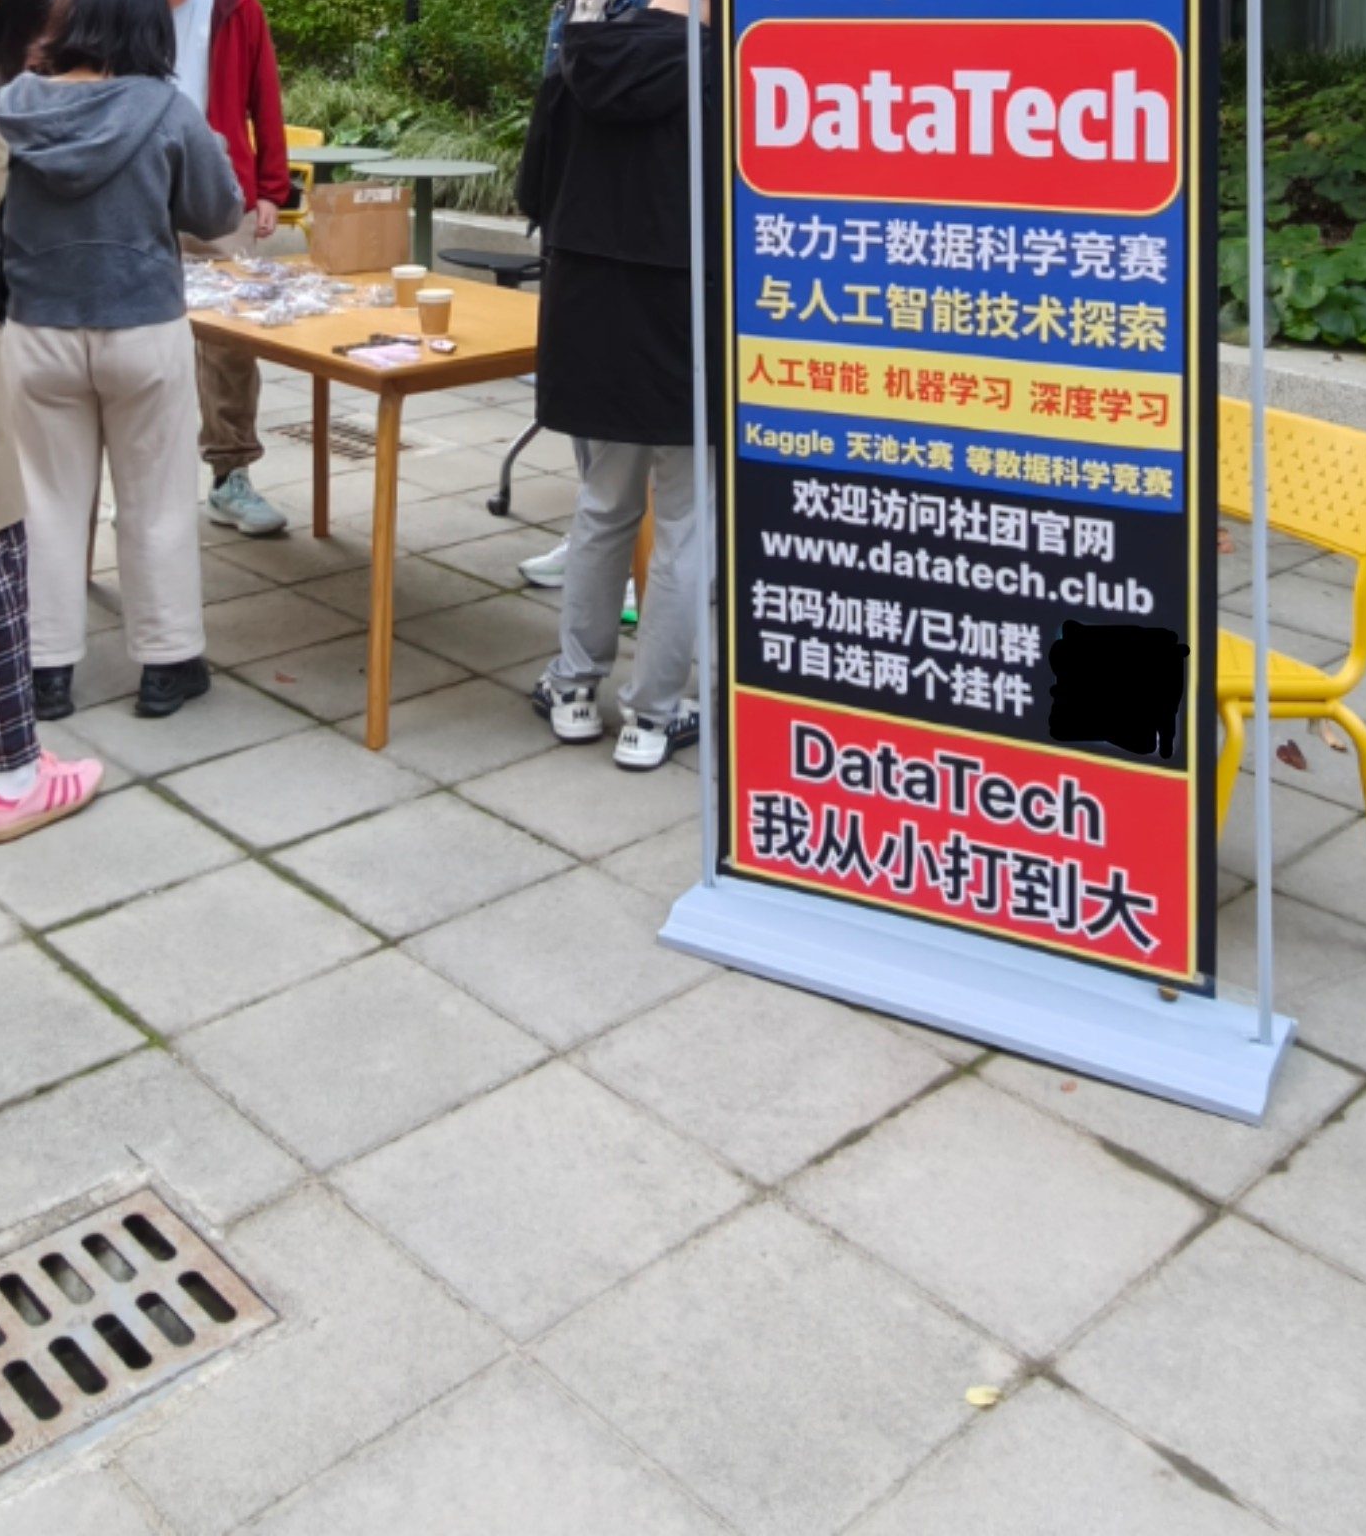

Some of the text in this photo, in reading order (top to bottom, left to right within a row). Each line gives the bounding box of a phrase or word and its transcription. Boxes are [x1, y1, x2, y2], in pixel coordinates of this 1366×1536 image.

[750, 66, 1170, 163] DataTech
[754, 213, 1169, 284] 致力于数据科学竞赛
[755, 276, 1168, 352] 与人工智能技术探索
[747, 354, 1170, 427] 人工智能 机器学习 深度学习
[745, 423, 1173, 499] Kaggle 天池大赛 等数据科学竞赛
[793, 479, 1115, 563] 欢迎访问社团官网
[761, 530, 1154, 614] www.datatech.club
[751, 580, 1042, 667] 扫码加群/已加群
[759, 632, 1034, 717] 可自选两个挂件
[791, 720, 1105, 847] DataTech
[750, 790, 1162, 952] 我从小打到大
